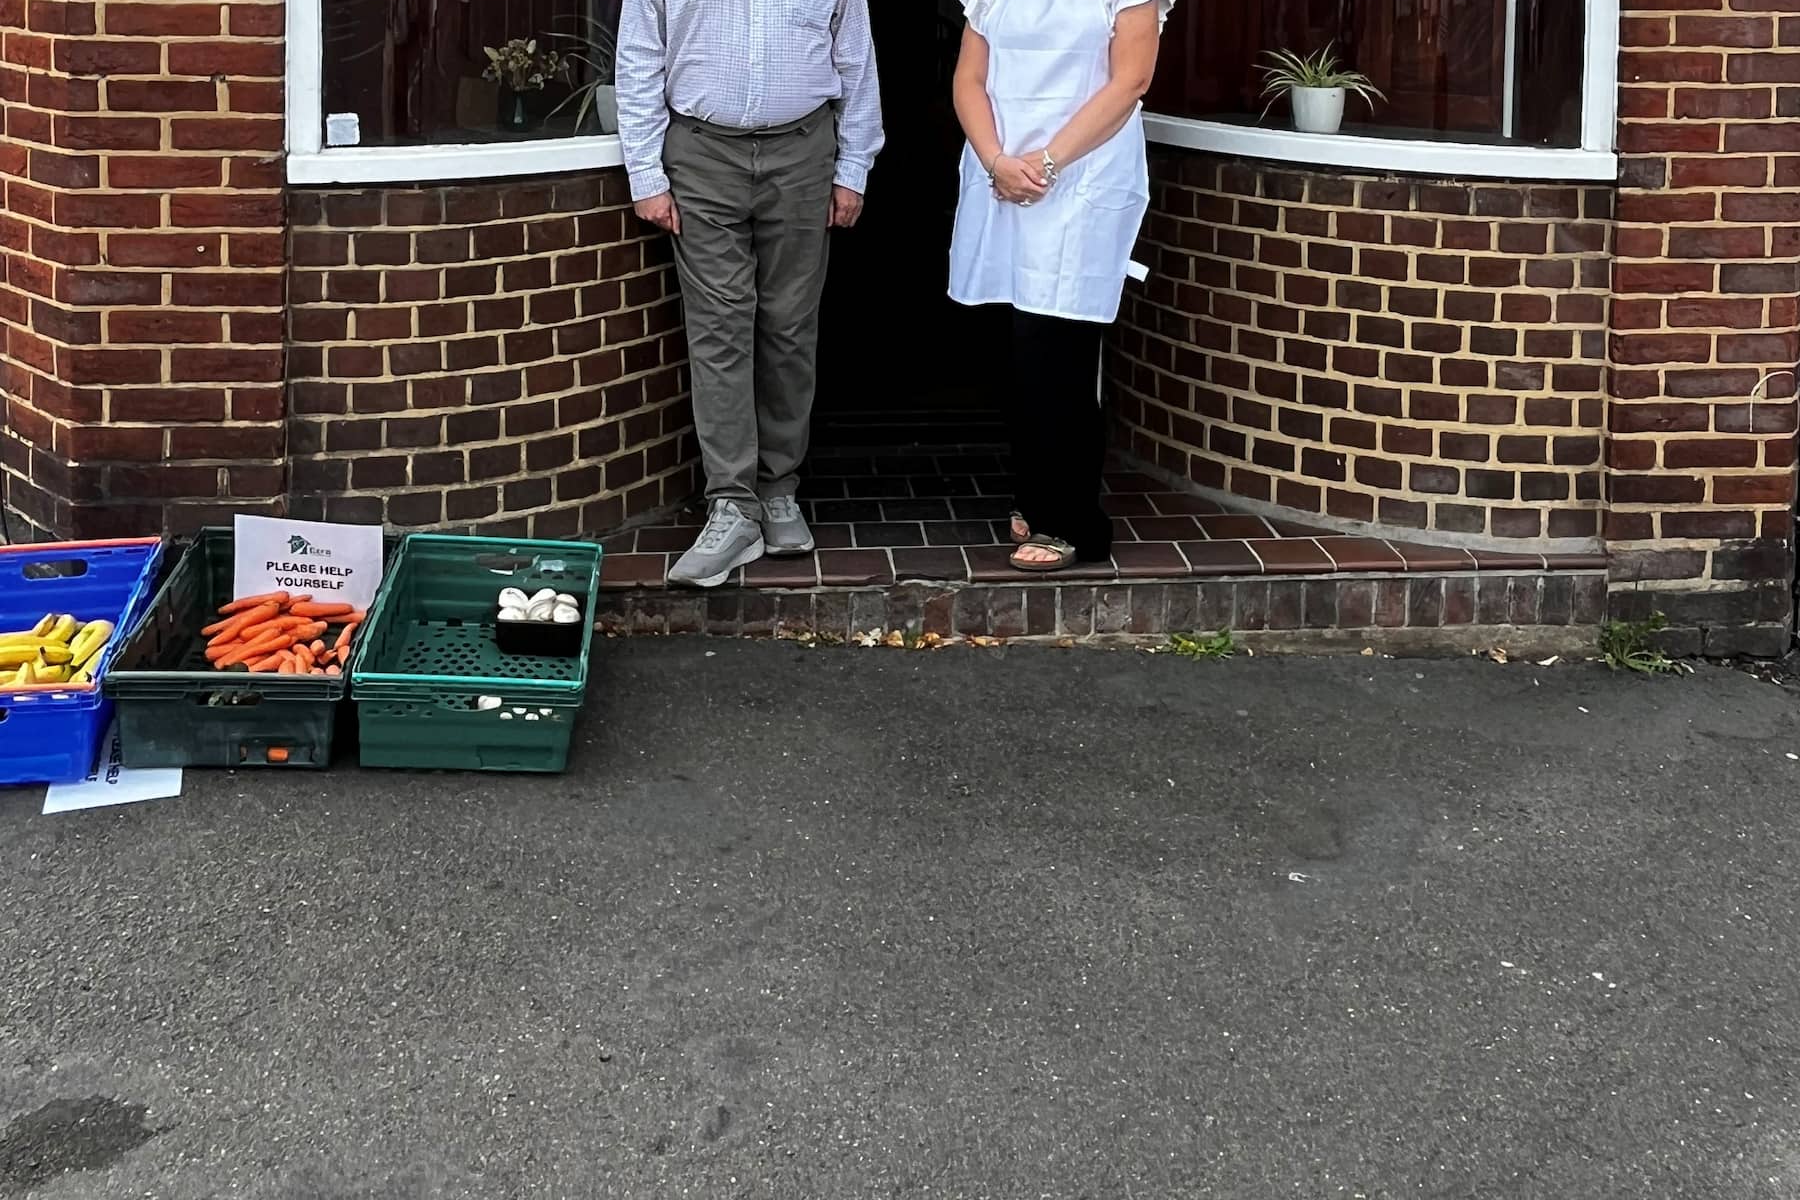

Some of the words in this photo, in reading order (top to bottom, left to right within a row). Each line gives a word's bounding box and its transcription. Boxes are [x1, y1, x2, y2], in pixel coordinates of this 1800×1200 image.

[266, 561, 317, 574] PLEASE
[319, 565, 354, 577] HELP
[275, 577, 344, 590] YOURSELF
